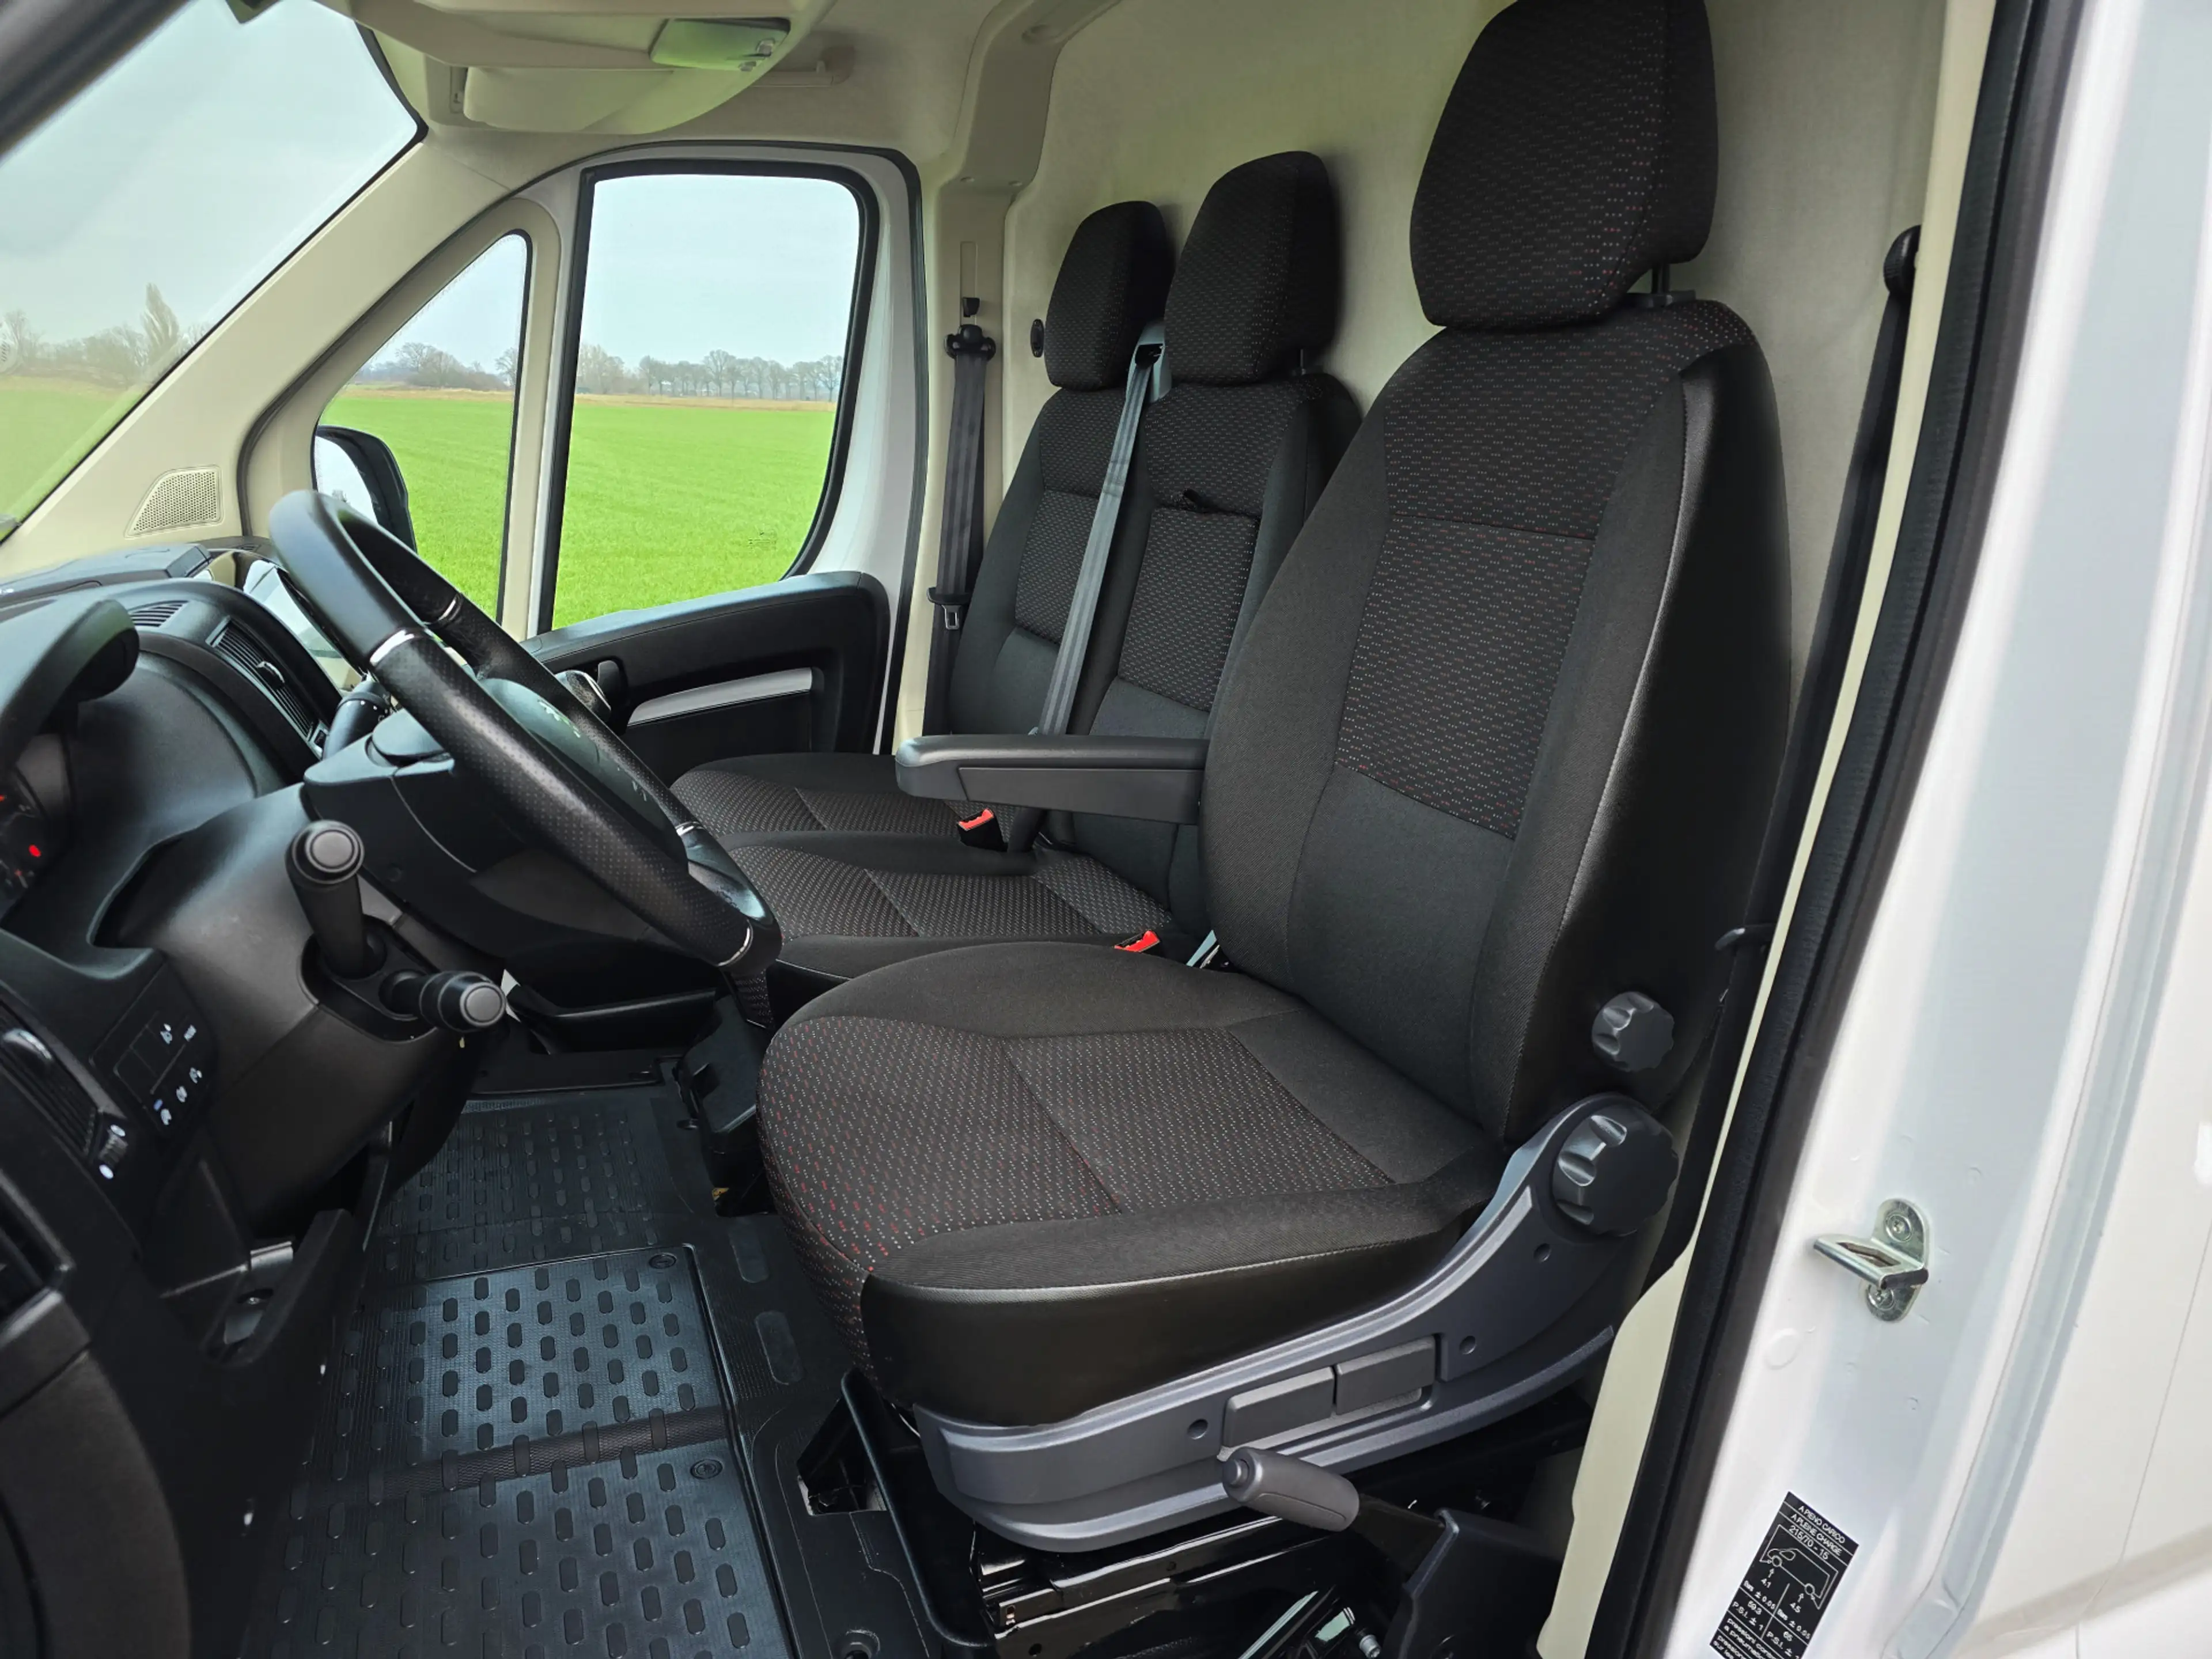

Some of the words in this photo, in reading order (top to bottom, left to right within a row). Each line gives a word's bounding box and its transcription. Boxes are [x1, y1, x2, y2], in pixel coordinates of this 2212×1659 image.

[1789, 1525, 1814, 1547] 215/70
[1819, 1548, 1830, 1560] 15
[1790, 1513, 1797, 1521] A
[1796, 1517, 1817, 1536] PLEINE
[1816, 1533, 1842, 1556] CHARGE
[1804, 1509, 1822, 1525] PIENO
[1822, 1523, 1845, 1543] CARICO
[1760, 1578, 1771, 1588] 4.1
[1790, 1602, 1801, 1613] 4.5
